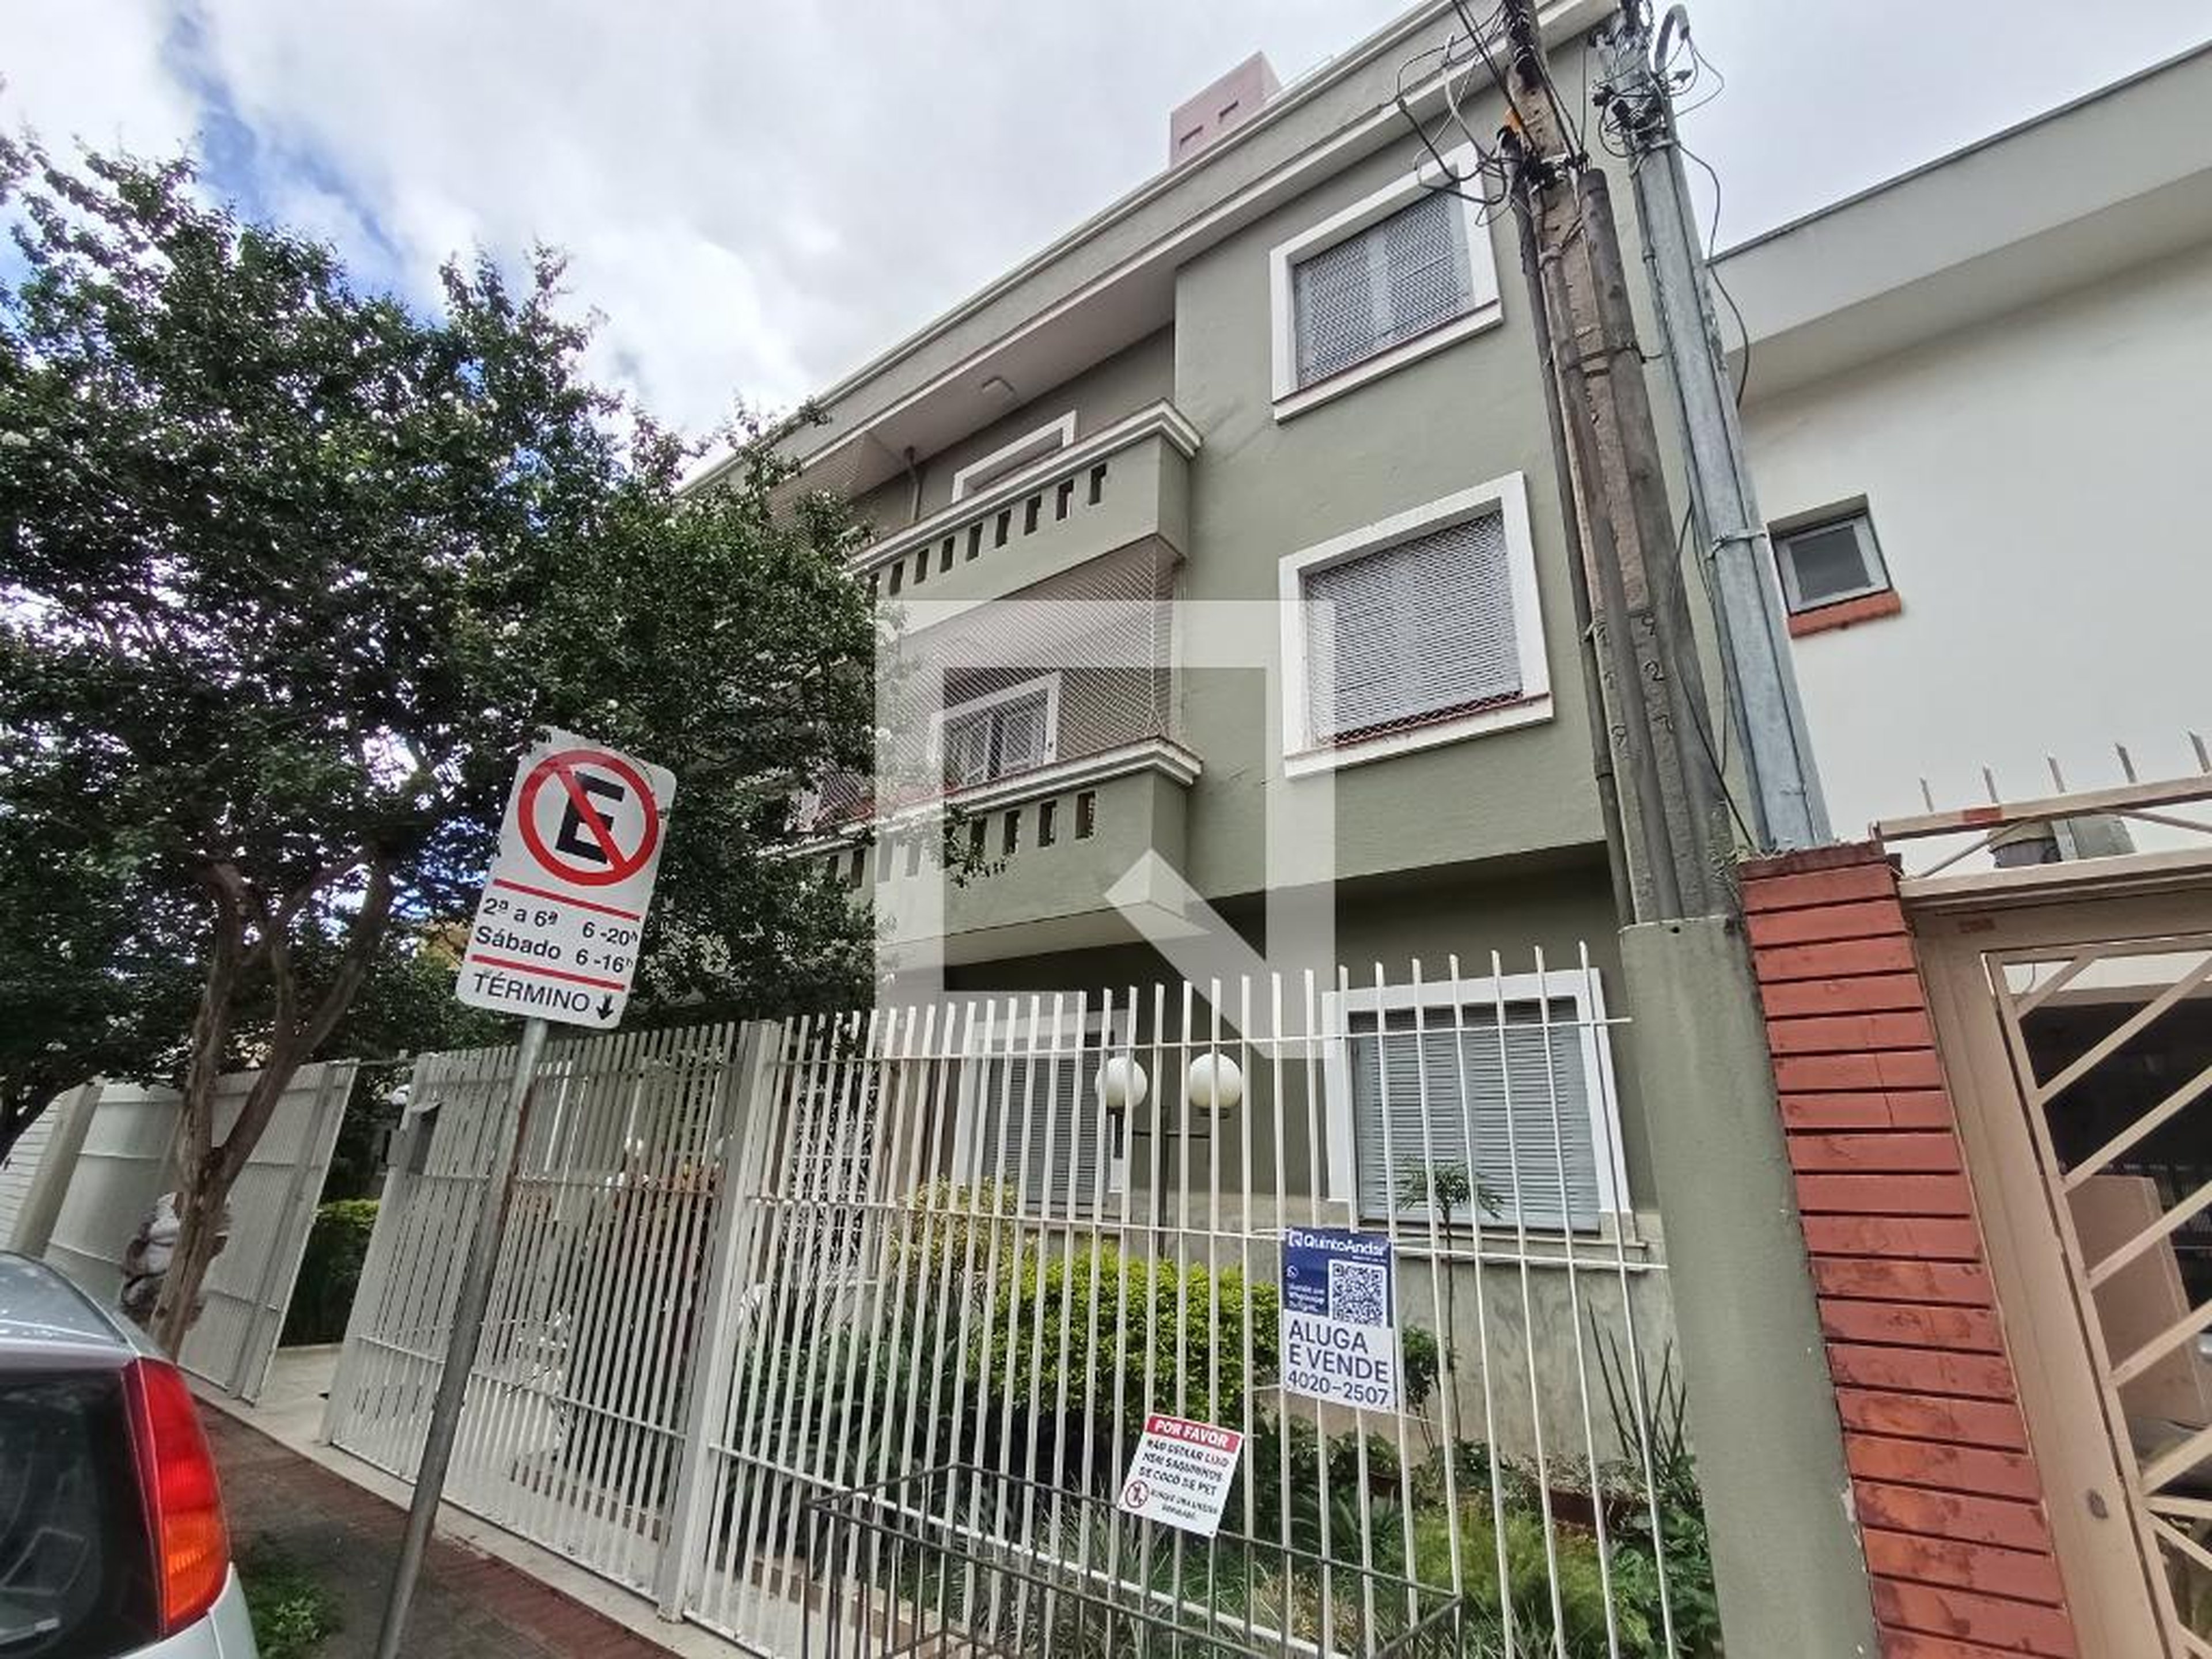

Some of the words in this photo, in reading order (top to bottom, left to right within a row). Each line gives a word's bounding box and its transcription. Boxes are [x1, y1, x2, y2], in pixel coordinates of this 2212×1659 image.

[513, 908, 527, 922] a
[582, 921, 595, 939] 6
[475, 925, 562, 960] Sábado
[575, 948, 589, 966] 6
[473, 971, 590, 1012] TÉRMINO
[1289, 1319, 1368, 1354] ALUGA
[1289, 1343, 1301, 1366] E
[1306, 1347, 1389, 1384] VENDE
[1288, 1370, 1389, 1406] 4020-2507
[1154, 1421, 1181, 1436] POR
[1183, 1425, 1229, 1448] FAVOR
